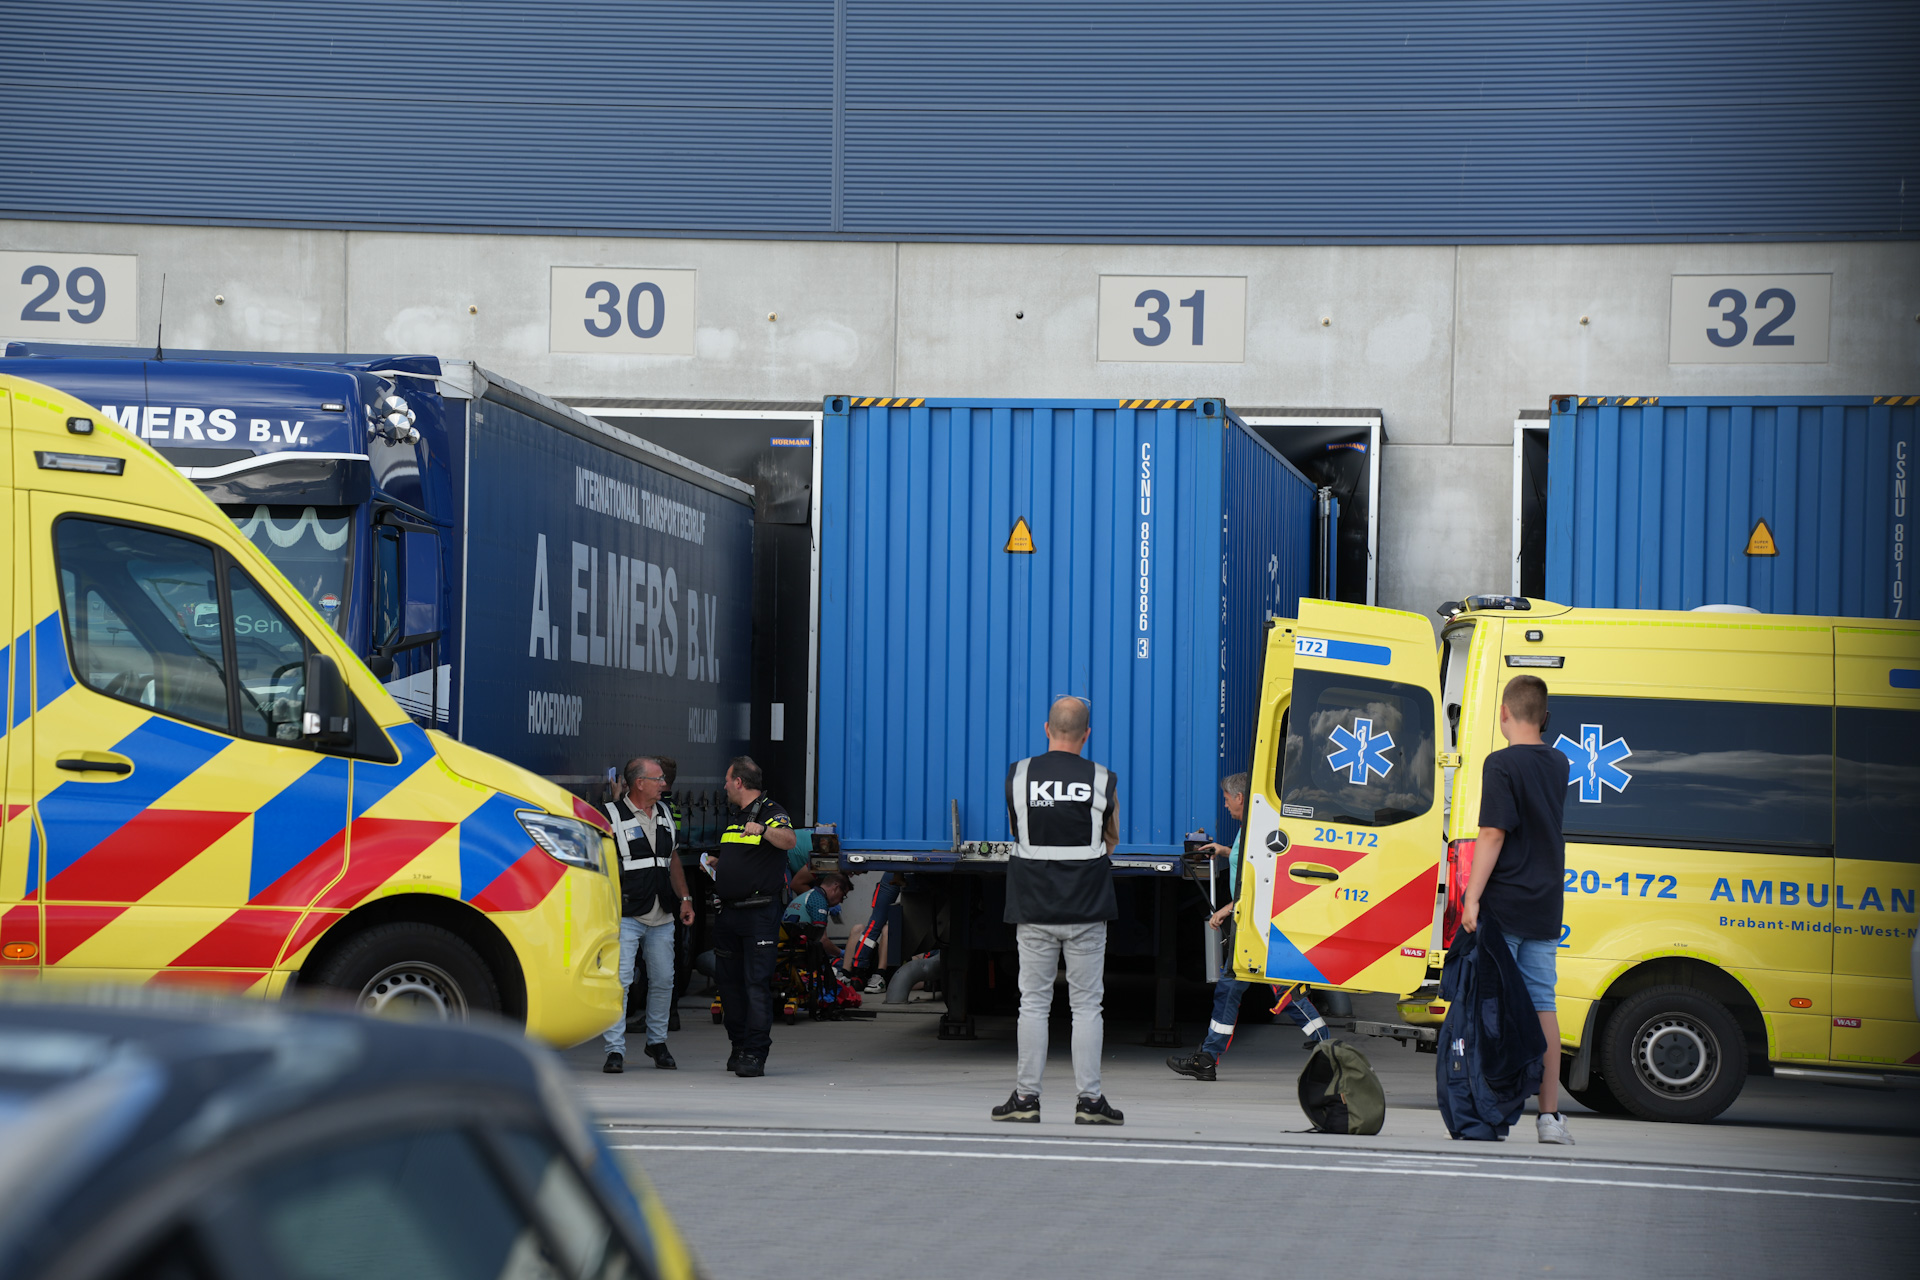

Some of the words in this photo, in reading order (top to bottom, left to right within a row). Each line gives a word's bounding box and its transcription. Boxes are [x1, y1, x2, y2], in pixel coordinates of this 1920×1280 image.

[20, 265, 106, 324] 29
[583, 281, 666, 339] 30
[1132, 289, 1206, 347] 31
[1706, 288, 1796, 347] 32
[249, 418, 308, 444] B.V.
[575, 465, 640, 525] INTERNATIONAAL
[641, 489, 706, 546] TRANSPORTBEDRIJF
[1141, 442, 1151, 516] CSNU
[1894, 441, 1907, 518] CSNU
[1138, 522, 1149, 632] 860986
[1893, 523, 1905, 619] 88107
[529, 533, 559, 661] A.
[570, 540, 678, 678] ELMERS
[687, 588, 720, 684] B.V.
[1138, 638, 1148, 658] 3
[1296, 640, 1323, 654] 172
[528, 690, 583, 736] HOOFDDORP
[688, 707, 718, 743] HOLLAND
[1030, 781, 1091, 802] KLG
[1313, 827, 1379, 848] 20-172
[1563, 868, 1678, 899] 20-172
[1709, 877, 1915, 914] AMBULAN
[1404, 948, 1423, 956] WAS
[1836, 1019, 1857, 1027] WAS
